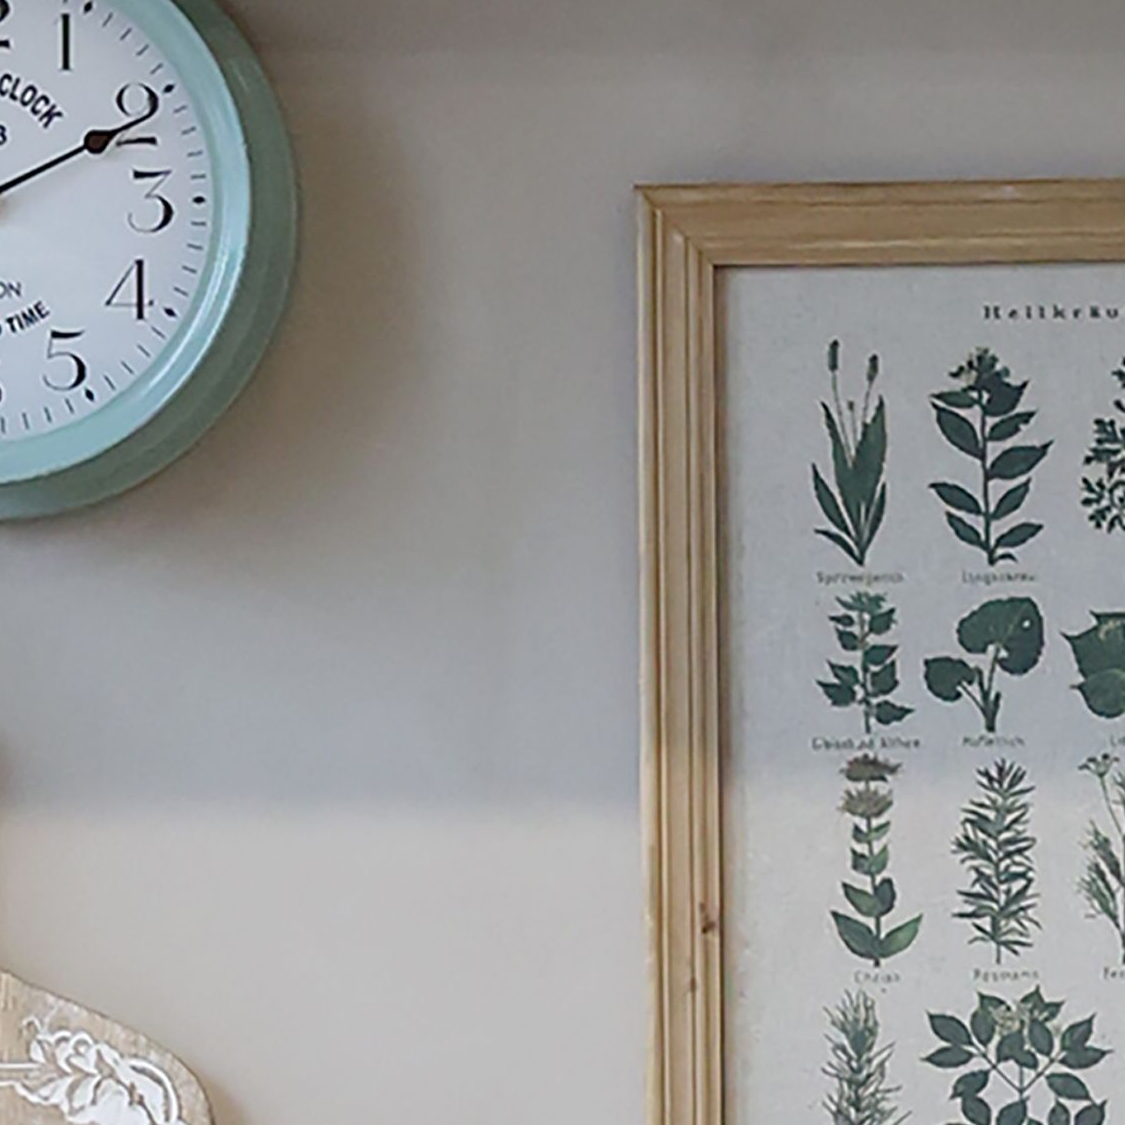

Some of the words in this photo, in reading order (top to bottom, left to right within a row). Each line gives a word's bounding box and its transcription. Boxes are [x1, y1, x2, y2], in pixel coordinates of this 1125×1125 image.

[58, 12, 72, 71] 1
[115, 82, 160, 148] 2
[127, 169, 174, 234] 3
[5, 300, 51, 334] TIME
[104, 259, 155, 321] 4
[43, 329, 87, 391] 5
